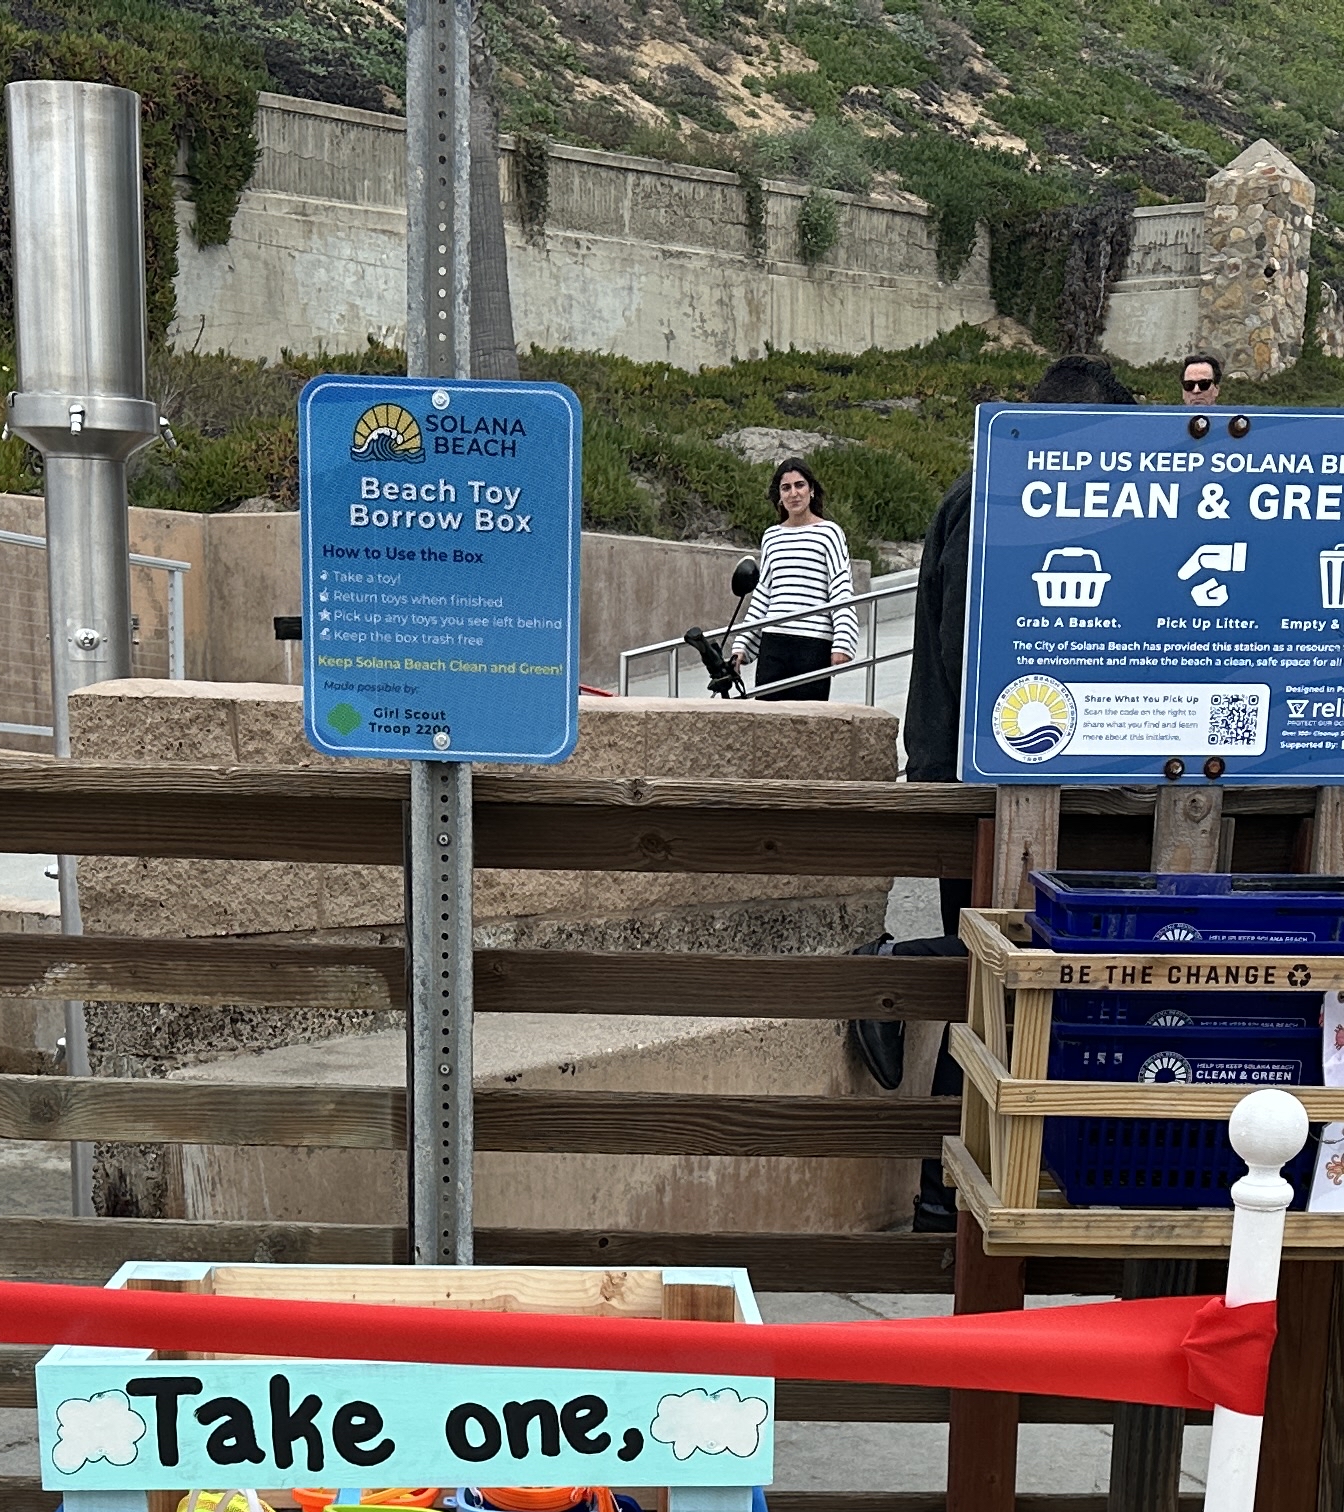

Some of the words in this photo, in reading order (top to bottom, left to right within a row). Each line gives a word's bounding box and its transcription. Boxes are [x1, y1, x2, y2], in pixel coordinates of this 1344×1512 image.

[426, 414, 526, 437] SOLANA
[434, 437, 516, 457] BEACH
[1026, 450, 1093, 471] HELP
[1099, 451, 1133, 472] US
[1139, 452, 1205, 473] KEEP
[1210, 453, 1315, 474] SOLANA
[361, 476, 456, 502] Beach
[468, 481, 522, 510] Toy
[1021, 481, 1180, 519] CLEAN
[1197, 483, 1231, 520] &
[350, 504, 463, 530] Borrow
[475, 508, 533, 533] Box
[322, 544, 362, 558] How
[364, 547, 381, 560] to
[386, 547, 416, 561] Use
[421, 547, 448, 562] the
[453, 549, 484, 563] Box
[333, 570, 363, 583] Take
[366, 574, 374, 584] a
[377, 572, 401, 586] toy!
[333, 590, 378, 603] Return
[381, 593, 408, 606] toys
[411, 593, 447, 606] when
[451, 594, 503, 608] finished
[333, 610, 361, 623] Pick
[365, 614, 382, 626] up
[385, 614, 408, 627] any
[411, 613, 438, 627] toys
[440, 616, 464, 629] you
[467, 617, 489, 628] see
[492, 615, 514, 629] left
[517, 616, 563, 631] behind
[1016, 616, 1050, 628] Grab
[1054, 617, 1064, 628] A
[1068, 617, 1122, 629] Basket.
[1156, 617, 1187, 629] Pick
[1192, 618, 1211, 631] Up
[1216, 617, 1259, 629] Litter.
[1281, 618, 1327, 631] Empty
[1330, 618, 1340, 630] &
[333, 629, 367, 643] Keep
[370, 630, 392, 643] the
[396, 631, 419, 644] box
[422, 632, 455, 646] trash
[458, 633, 484, 646] free
[1013, 640, 1032, 650] The
[1034, 640, 1054, 652] City
[1057, 640, 1069, 650] of
[1070, 641, 1105, 651] Solana
[1108, 641, 1141, 651] Beach
[1143, 641, 1162, 651] has
[1163, 642, 1210, 653] provided
[1212, 642, 1232, 651] this
[1234, 642, 1270, 652] station
[1273, 644, 1284, 652] as
[1287, 644, 1293, 652] a
[1295, 644, 1340, 652] resource
[318, 655, 353, 669] Keep
[355, 656, 401, 670] Solana
[404, 658, 446, 672] Beach
[449, 659, 487, 673] Clean
[490, 660, 516, 674] and
[519, 662, 563, 676] Green!
[1016, 656, 1035, 665] the
[1037, 656, 1104, 666] environment
[1106, 656, 1127, 666] and
[1129, 656, 1158, 666] make
[1160, 656, 1179, 666] the
[1181, 656, 1212, 666] beach
[1224, 657, 1254, 668] clean,
[1256, 657, 1278, 667] safe
[1280, 658, 1310, 668] space
[1313, 657, 1328, 667] for
[1330, 657, 1342, 667] all
[323, 680, 354, 691] Made
[357, 682, 402, 693] possible
[1285, 685, 1325, 694] Designed
[1084, 695, 1112, 703] Share
[1115, 695, 1140, 703] What
[1142, 695, 1160, 703] You
[1162, 695, 1183, 703] Pick
[1186, 695, 1199, 704] Up
[373, 707, 399, 720] Girl
[405, 708, 446, 721] Scout
[368, 722, 411, 736] Troop
[415, 723, 451, 735] 2200
[1280, 741, 1323, 749] Supported
[1325, 741, 1339, 749] By:
[1060, 965, 1092, 984] BE
[1106, 965, 1154, 984] THE
[1168, 965, 1277, 985] CHANGE
[1196, 1070, 1236, 1080] CLEAN
[1239, 1071, 1248, 1080] &
[1251, 1071, 1292, 1081] GREEN
[126, 1373, 395, 1472] Take
[445, 1393, 645, 1462] one,
